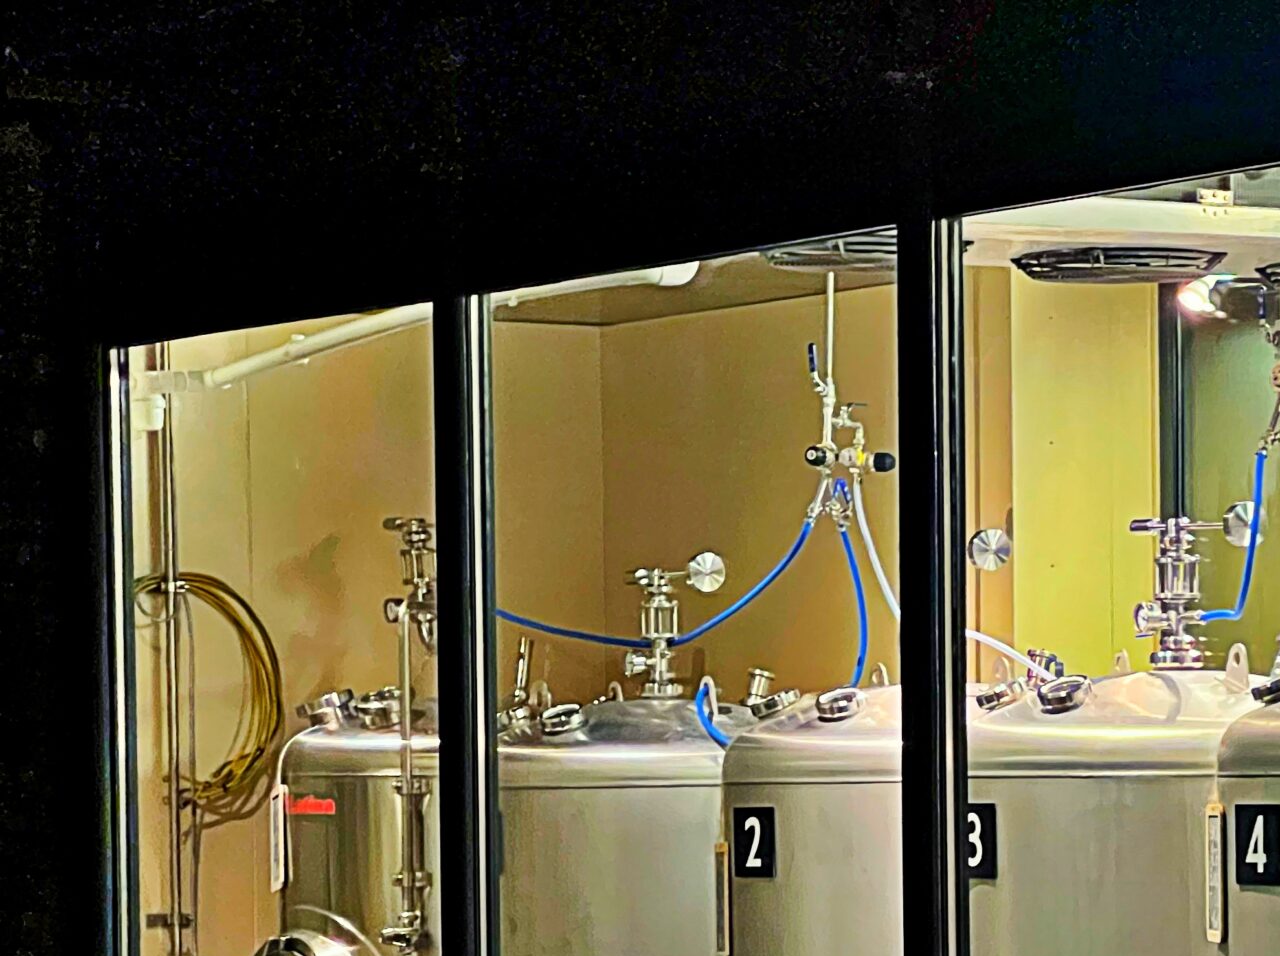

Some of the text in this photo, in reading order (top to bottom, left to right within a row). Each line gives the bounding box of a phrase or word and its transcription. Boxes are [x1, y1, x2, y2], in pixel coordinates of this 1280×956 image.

[744, 816, 762, 868] 2
[967, 812, 983, 867] 3
[1245, 814, 1268, 874] 4
